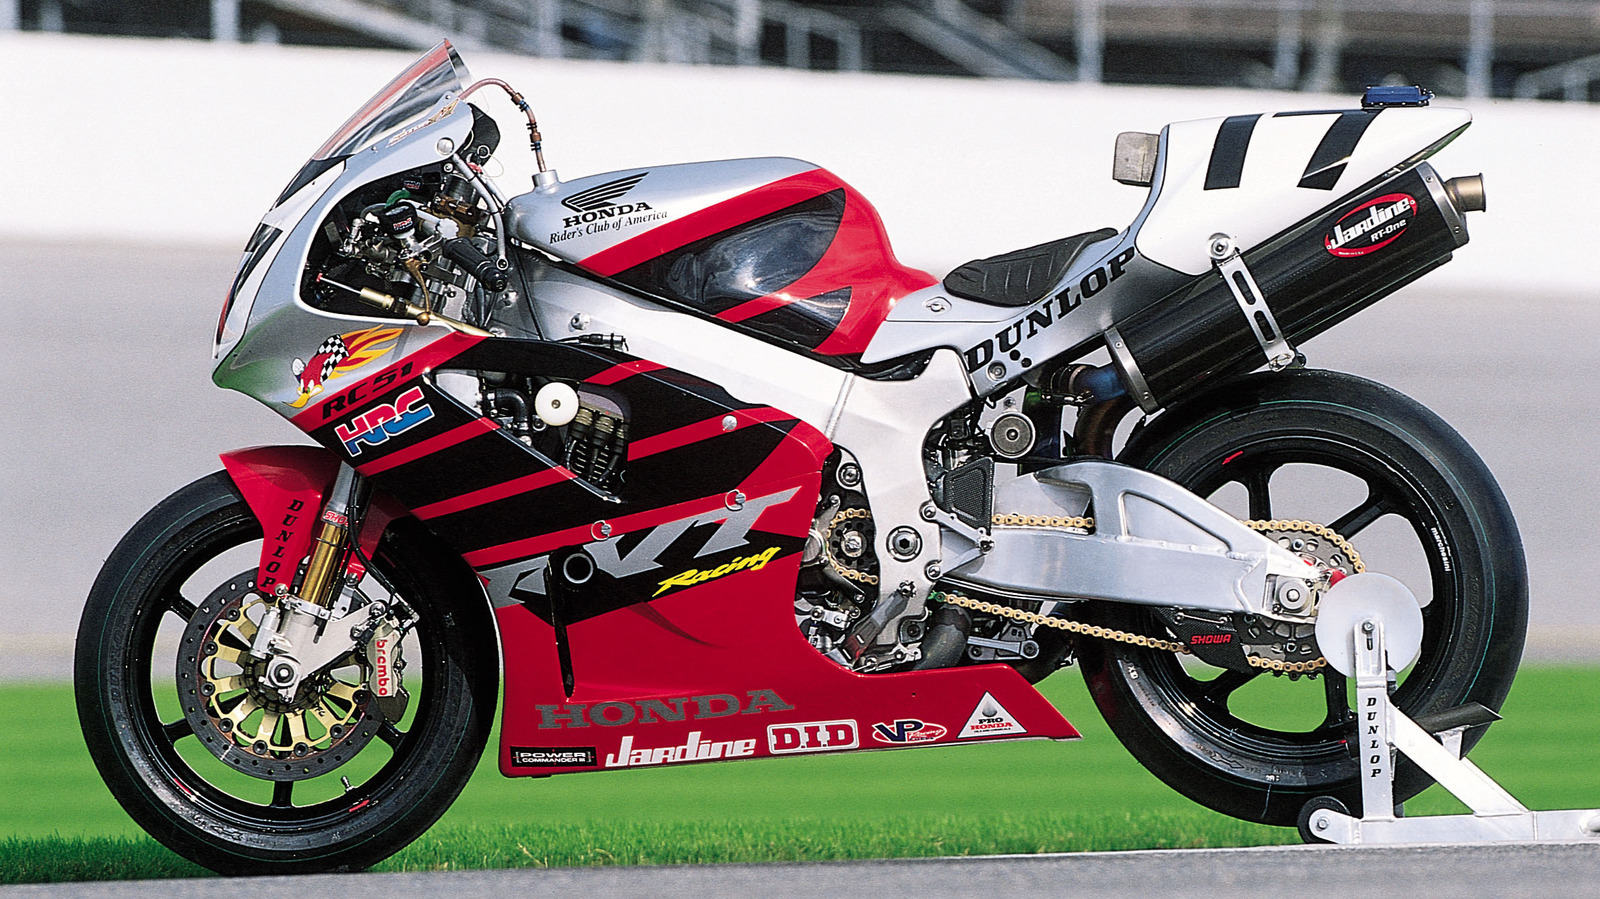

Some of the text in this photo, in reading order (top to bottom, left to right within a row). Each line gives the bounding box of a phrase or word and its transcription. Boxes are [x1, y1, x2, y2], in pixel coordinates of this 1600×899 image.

[1204, 109, 1383, 190] 17
[549, 210, 668, 244] Rider's Club of America
[562, 202, 653, 228] HONDA
[1330, 197, 1411, 250] Jardine
[1370, 219, 1407, 242] RT-One
[964, 246, 1135, 373] DUNLOP
[321, 361, 414, 420] RC51
[335, 386, 434, 456] HRC
[323, 510, 360, 527] SHO
[259, 499, 303, 588] DUNLOP
[652, 547, 782, 597] Racing
[1190, 634, 1232, 645] SHOWA
[376, 639, 390, 696] brembo
[536, 689, 795, 730] HONDA
[872, 719, 925, 743] VP
[970, 722, 1014, 730] HONDA
[605, 731, 756, 768] Jardine
[1366, 697, 1382, 778] DUNLOP
